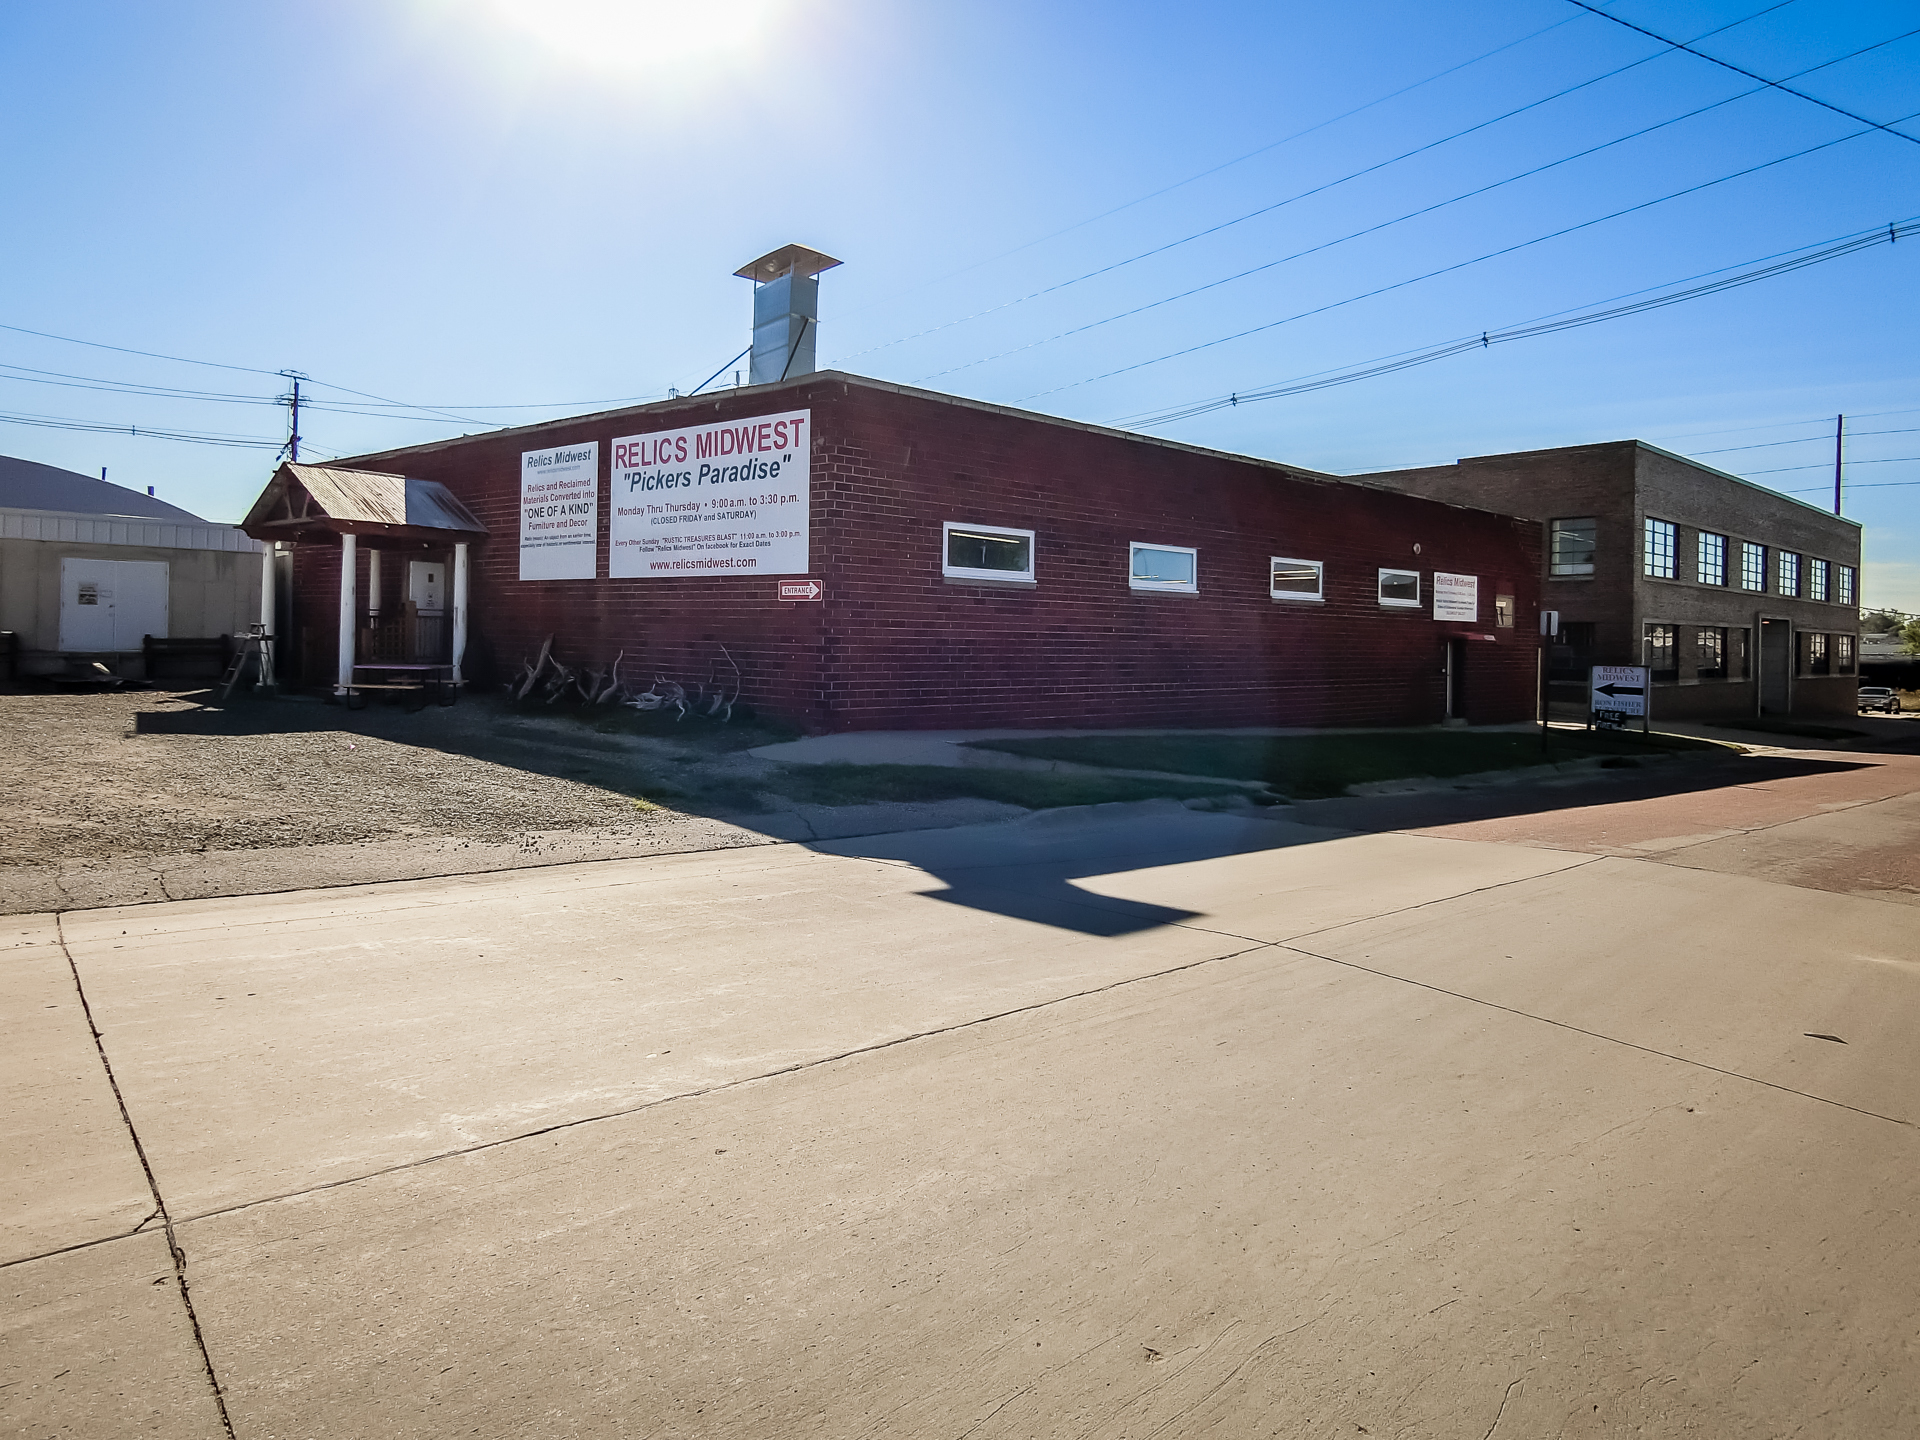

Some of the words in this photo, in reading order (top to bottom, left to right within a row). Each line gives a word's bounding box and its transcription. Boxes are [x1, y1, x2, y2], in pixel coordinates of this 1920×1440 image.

[615, 436, 688, 470] RELICS
[696, 418, 805, 460] MIDWEST
[527, 455, 552, 468] Relics
[554, 449, 592, 464] Midwest
[624, 469, 691, 492] "Pickers
[698, 454, 792, 486] Paradise"
[528, 483, 546, 493] Relics
[546, 482, 558, 490] and
[559, 478, 591, 490] Reclaimed
[523, 494, 549, 504] Materials
[550, 491, 582, 502] Converted
[524, 507, 545, 519] "ONE
[547, 506, 558, 518] OF
[560, 504, 567, 516] A
[568, 503, 594, 516] KIND"
[618, 506, 644, 517] Monday
[647, 504, 663, 514] Thru
[665, 501, 700, 512] Thursday
[712, 499, 728, 508] 9:00
[729, 499, 746, 507] a.m.
[750, 497, 757, 506] to
[760, 494, 778, 505] 3:30
[781, 494, 800, 506] p.m.
[528, 521, 555, 530] Furniture
[556, 519, 568, 528] and
[569, 519, 588, 528] Decor
[651, 516, 677, 526] (CLOSED
[680, 514, 702, 523] FRIDAY
[704, 513, 715, 521] and
[717, 510, 756, 520] SATURDAY)
[642, 538, 660, 546] Sunday
[662, 536, 682, 544] "RUSTIC
[684, 534, 716, 543] TREASURES
[740, 532, 754, 540] 11:00
[706, 542, 729, 550] facebook
[740, 540, 754, 548] Exact
[650, 558, 757, 570] www.relicsmidwest.com
[1436, 576, 1453, 586] Relics
[1454, 577, 1475, 589] Midwest
[1603, 666, 1634, 674] RELICS
[1597, 674, 1640, 682] MIDWEST
